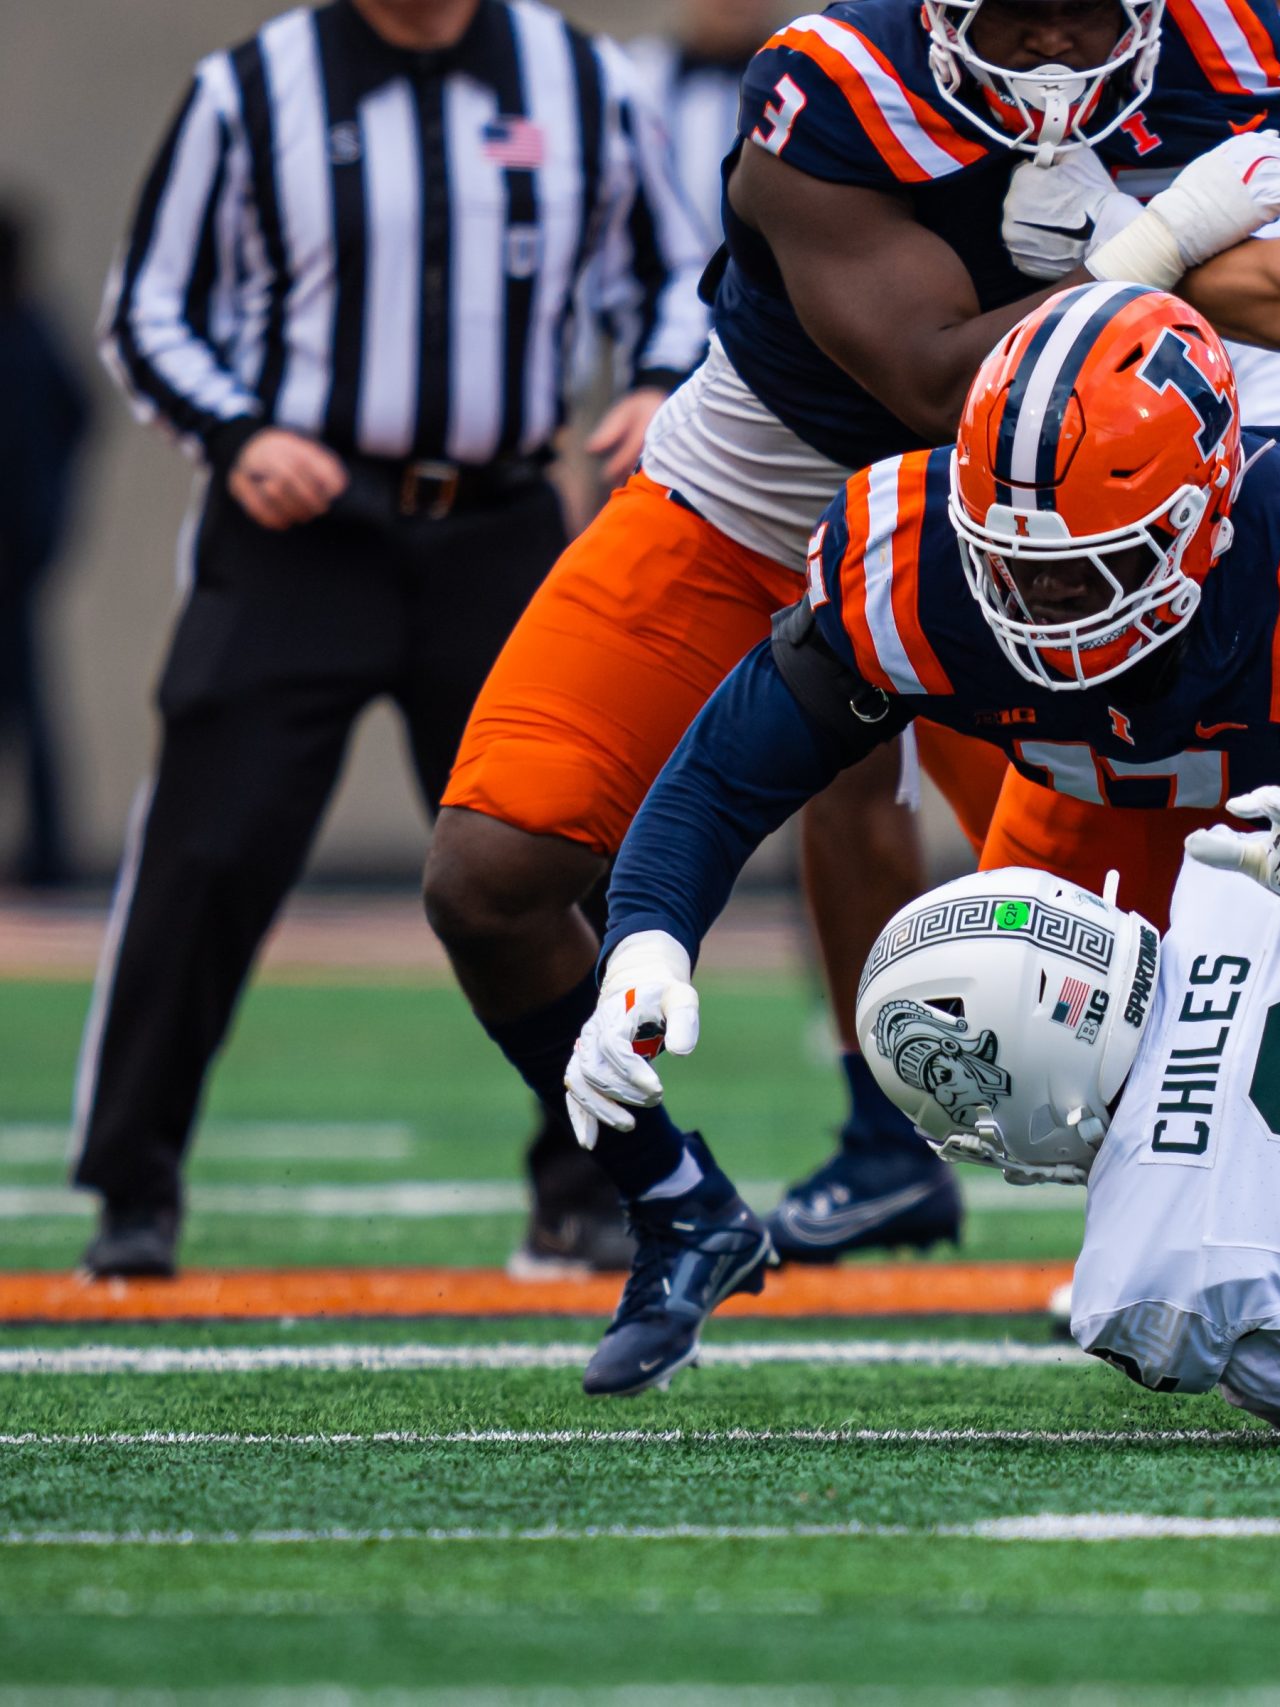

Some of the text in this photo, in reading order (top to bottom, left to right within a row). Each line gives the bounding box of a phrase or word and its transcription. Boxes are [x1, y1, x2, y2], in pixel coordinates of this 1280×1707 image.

[752, 73, 806, 157] 3
[1003, 902, 1020, 927] C2P
[1123, 925, 1159, 1029] SPARTANS
[1151, 954, 1252, 1156] CHILES
